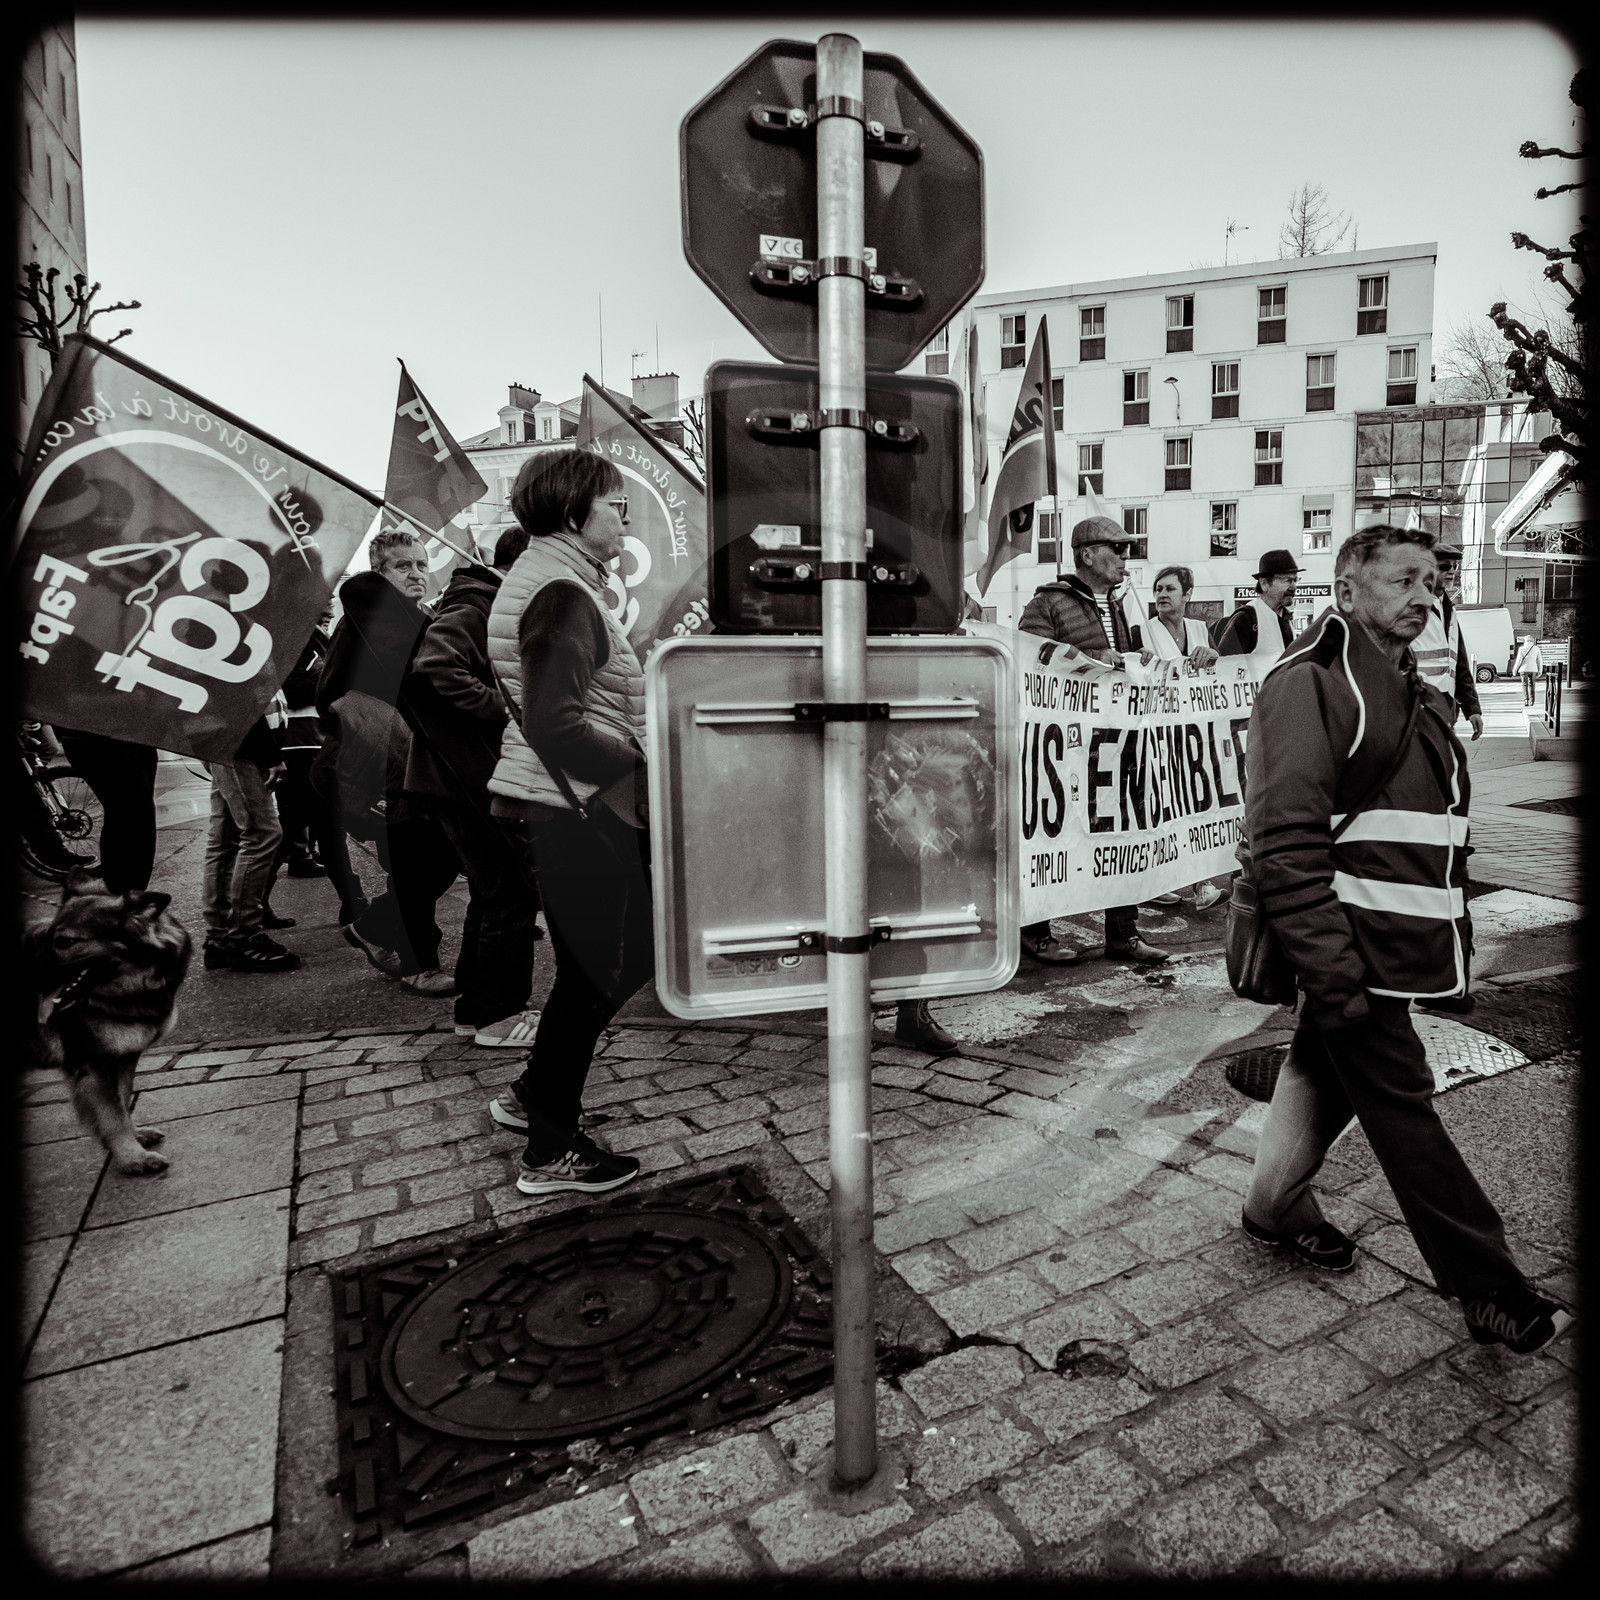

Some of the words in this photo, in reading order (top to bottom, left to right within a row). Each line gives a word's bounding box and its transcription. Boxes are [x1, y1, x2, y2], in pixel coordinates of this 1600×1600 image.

[1295, 586, 1329, 596] outure
[1189, 680, 1229, 713] PRIVÉS
[1022, 721, 1066, 840] US
[1088, 718, 1251, 834] ENSEMBLE
[1030, 851, 1068, 888] EMPLOI
[1093, 842, 1150, 877] SERVICES
